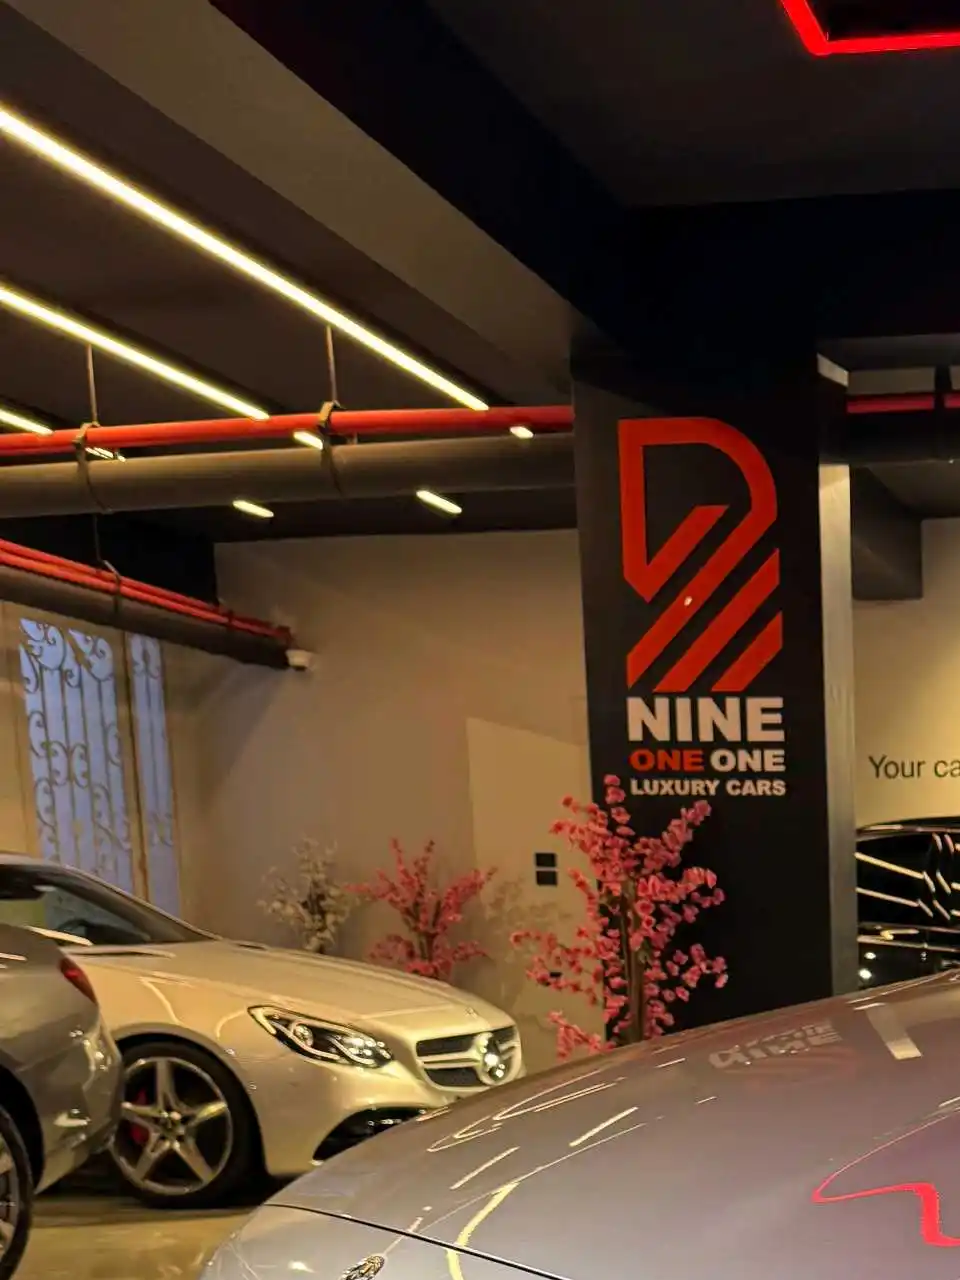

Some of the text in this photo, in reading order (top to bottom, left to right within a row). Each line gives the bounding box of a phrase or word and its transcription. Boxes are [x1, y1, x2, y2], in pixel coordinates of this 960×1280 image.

[626, 697, 785, 742] NINE
[629, 749, 786, 772] ONE ONE
[868, 754, 926, 779] Your
[630, 778, 786, 796] LUXURY CARS
